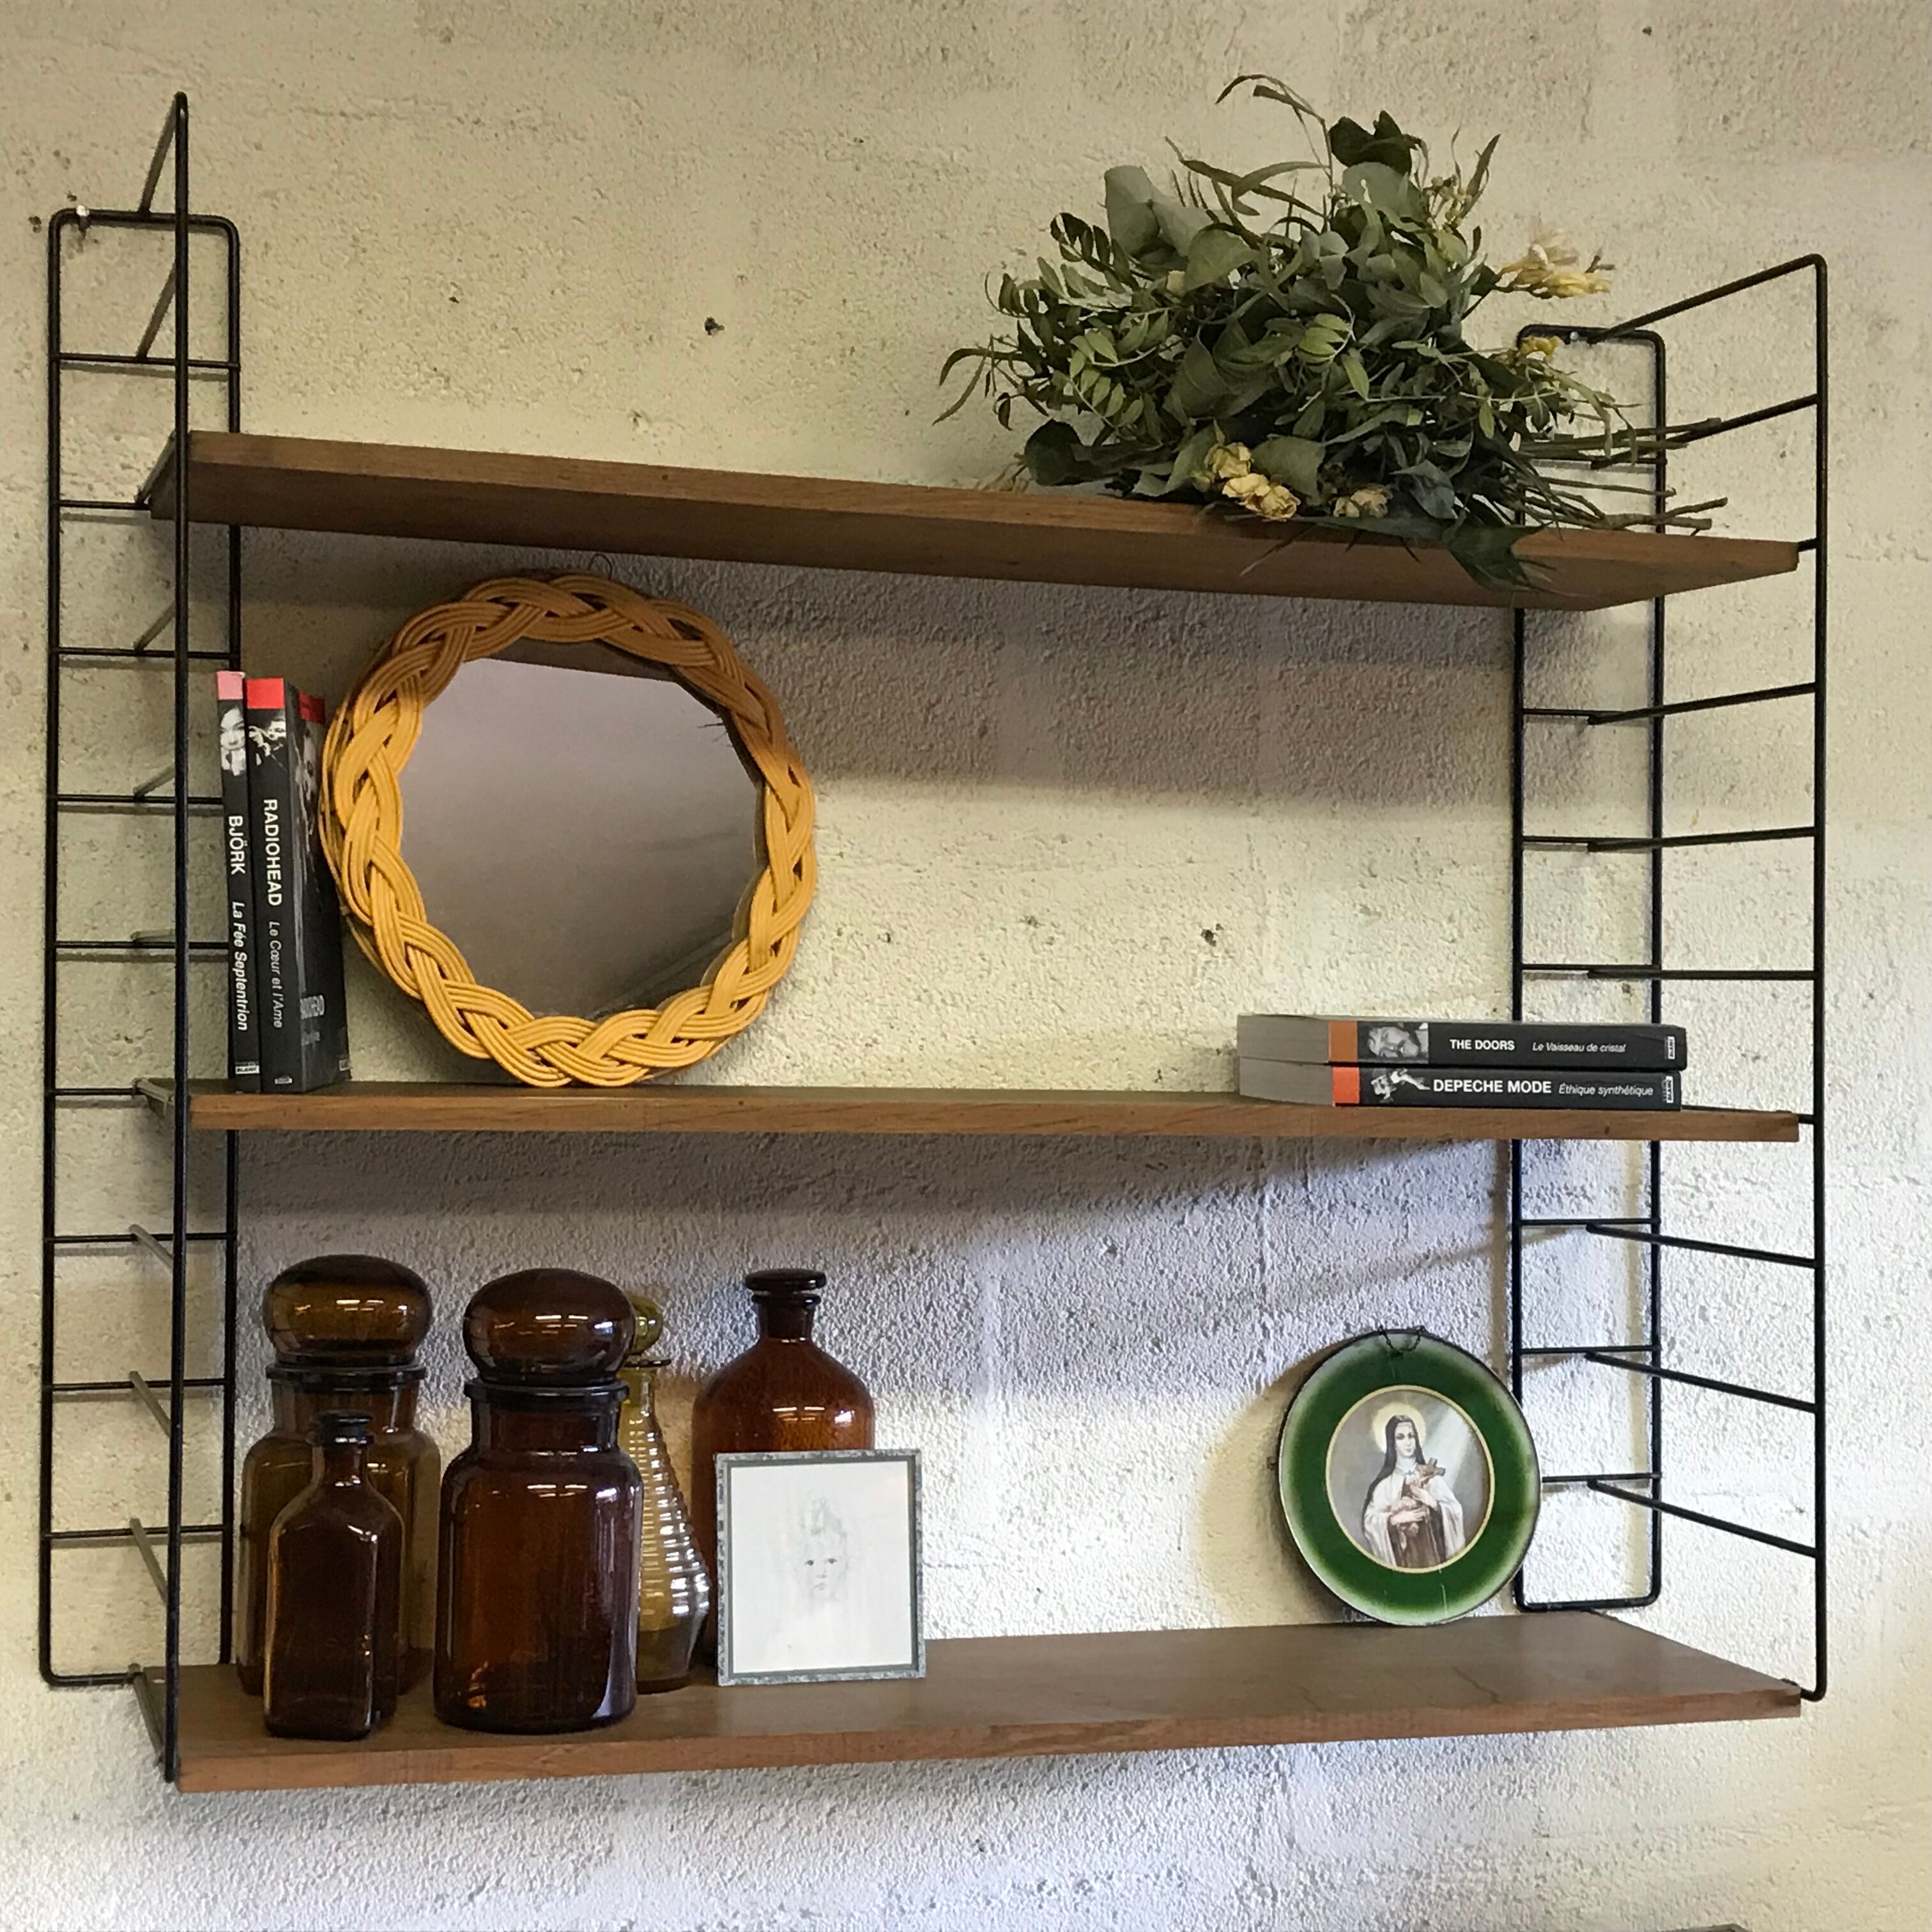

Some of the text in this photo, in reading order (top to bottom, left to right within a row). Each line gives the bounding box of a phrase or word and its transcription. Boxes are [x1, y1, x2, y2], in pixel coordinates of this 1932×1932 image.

[228, 815, 247, 875] BJÖRK
[263, 799, 282, 906] RADIOHEAD
[269, 921, 280, 937] Le
[232, 901, 250, 1031] La Fée Septentrion
[269, 941, 282, 975] Cœur
[271, 977, 282, 990] et
[1449, 1039, 1515, 1051] THE DOORS
[1533, 1042, 1626, 1053] Le Vaisseau de cristal
[1433, 1080, 1552, 1094] DEPECHE MODE
[1559, 1082, 1596, 1096] Éthique
[1598, 1085, 1653, 1098] synthétique
